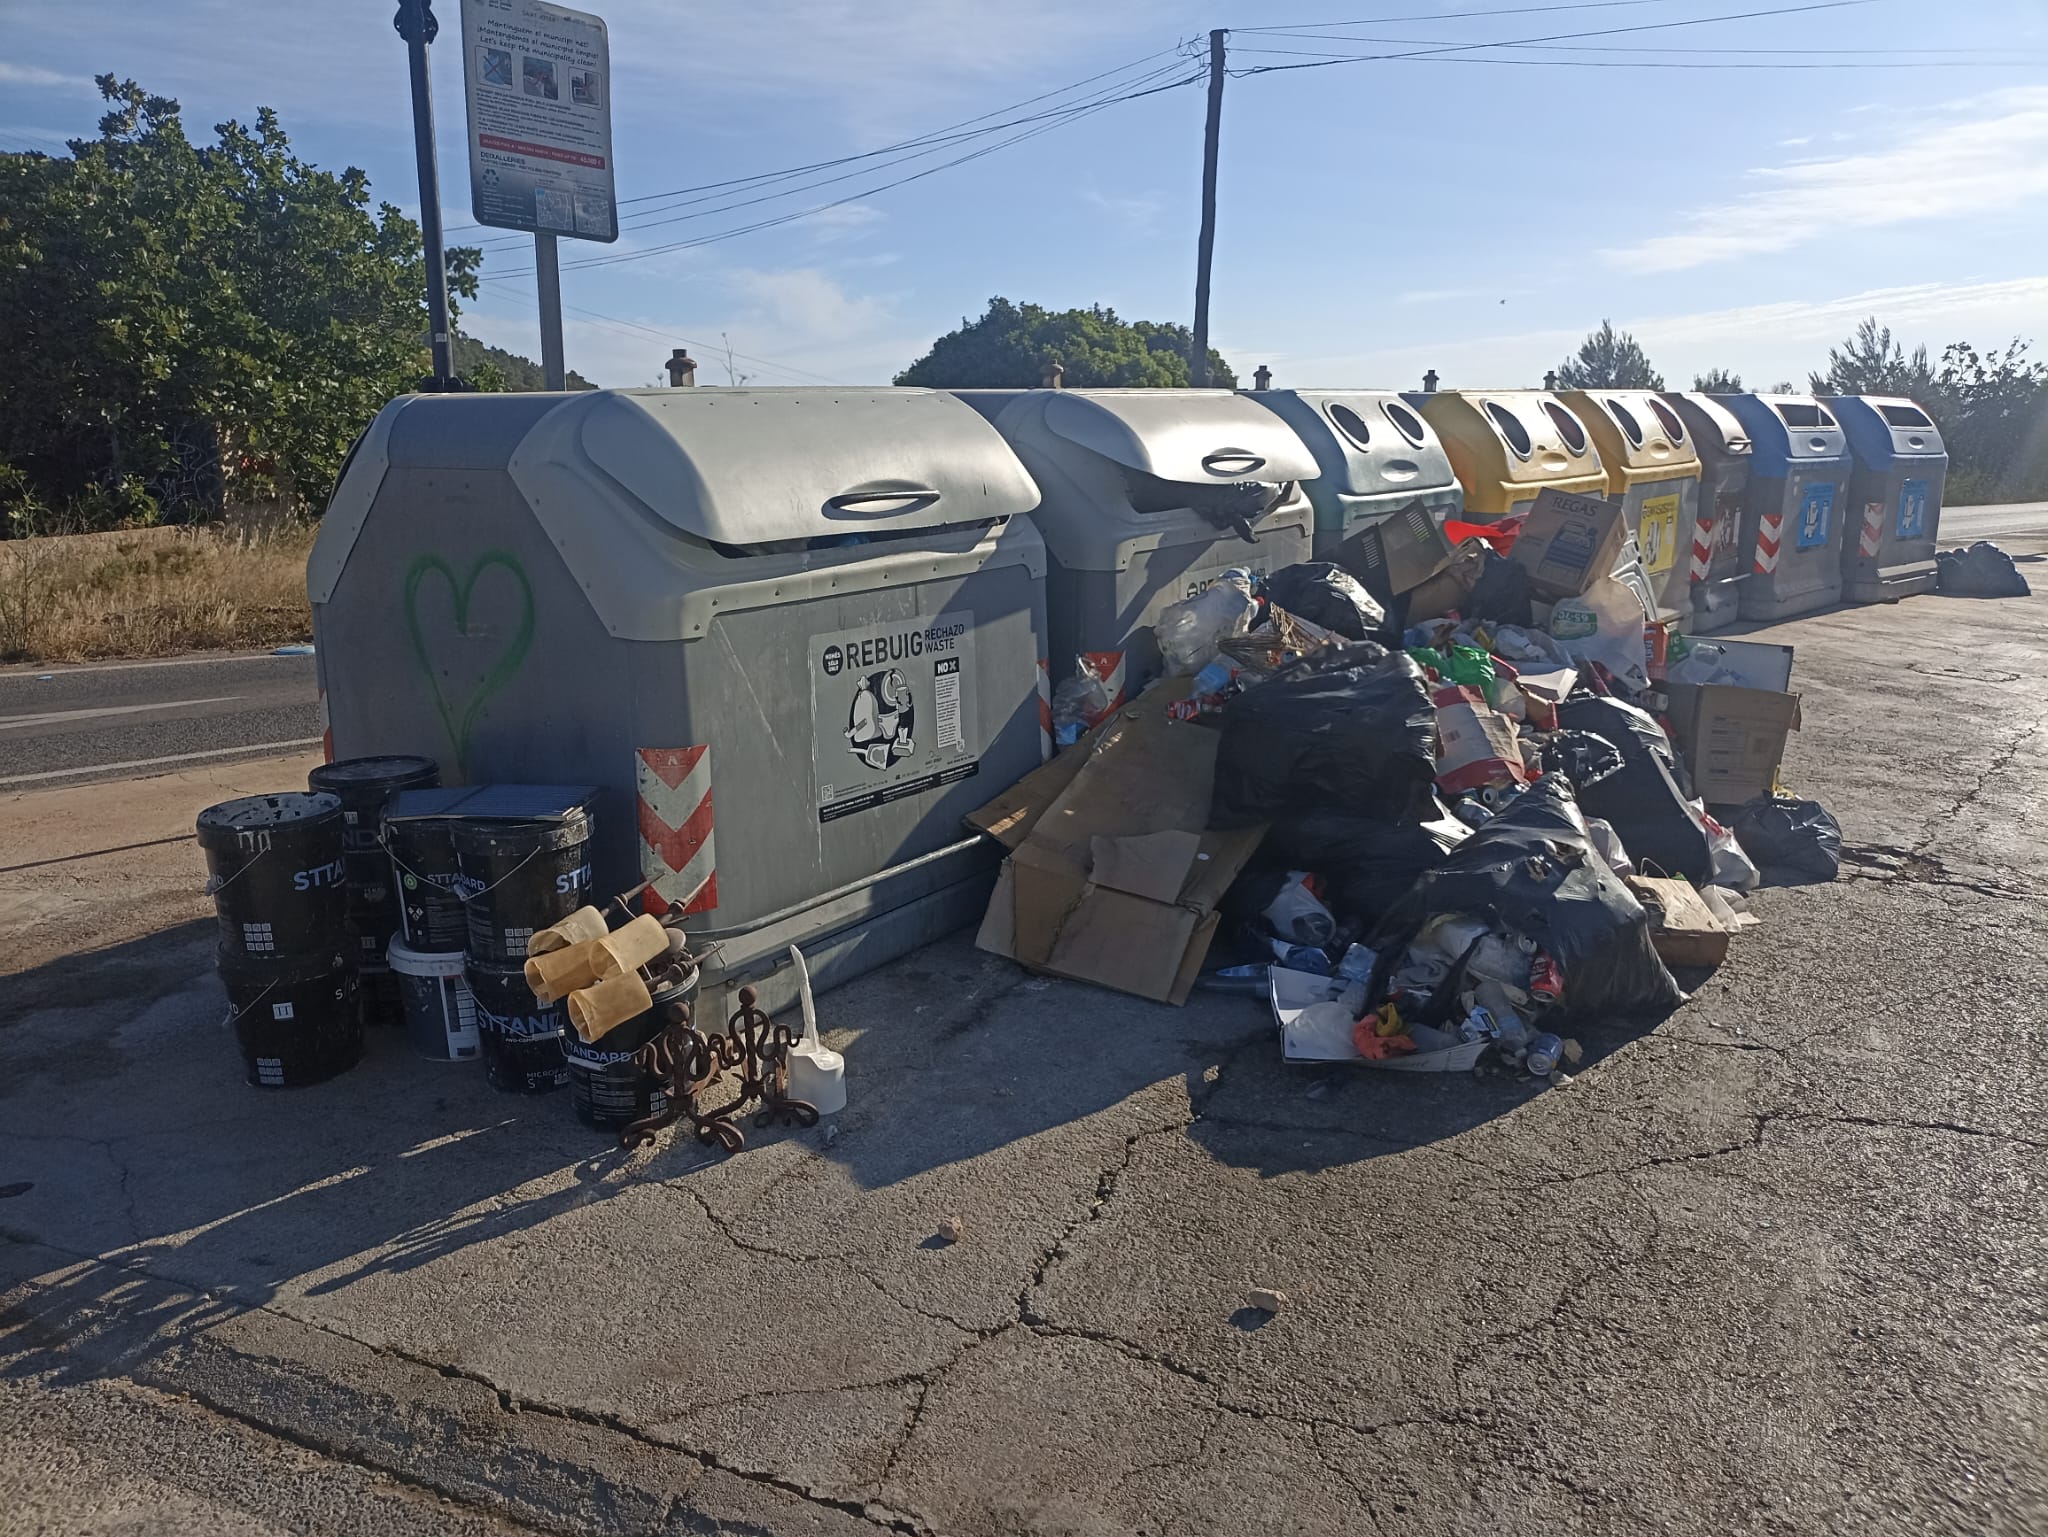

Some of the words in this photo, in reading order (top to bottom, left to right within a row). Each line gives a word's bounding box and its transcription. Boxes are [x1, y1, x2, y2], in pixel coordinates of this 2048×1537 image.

[924, 623, 965, 641] RECHAZO
[846, 631, 923, 670] REBUIG
[924, 638, 955, 654] WASTE
[937, 661, 949, 674] NO
